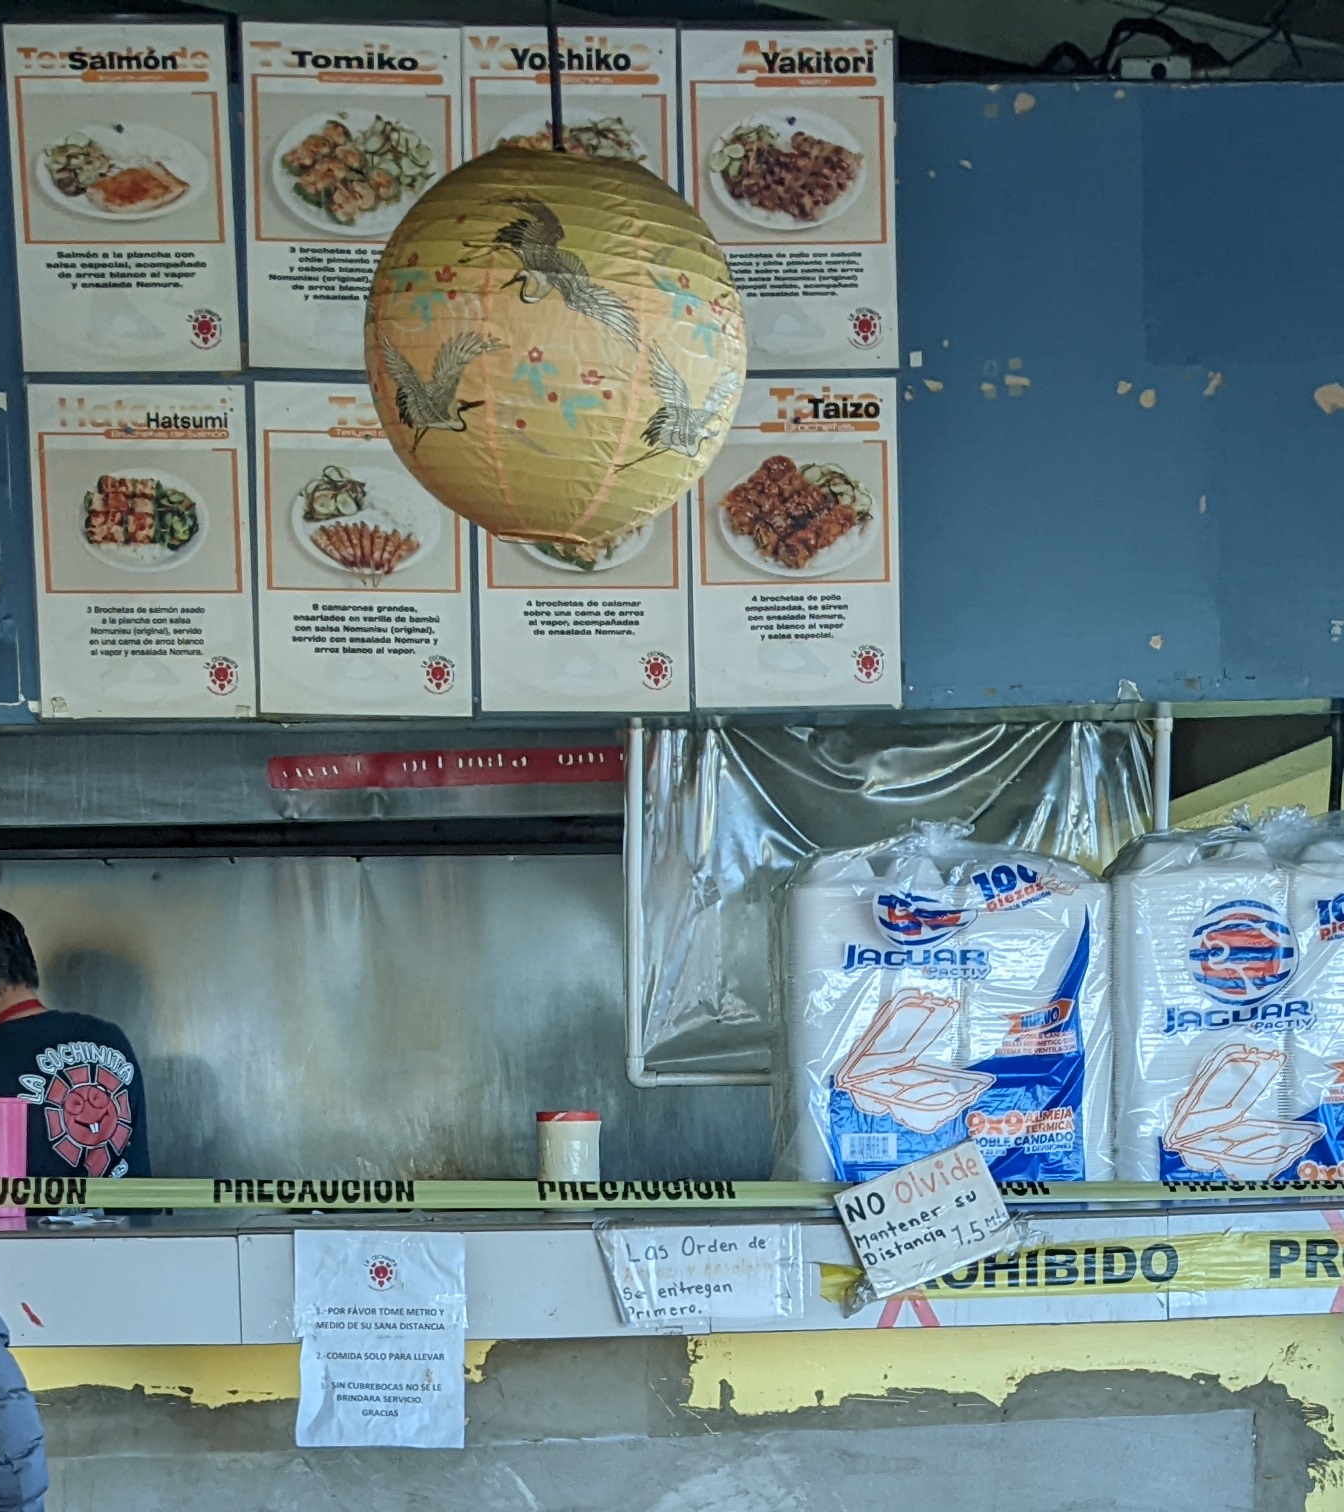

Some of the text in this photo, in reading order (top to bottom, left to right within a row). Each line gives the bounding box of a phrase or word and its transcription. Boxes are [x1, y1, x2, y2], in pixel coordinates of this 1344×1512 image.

[68, 48, 178, 70] Salmón
[291, 51, 418, 71] Tomiko
[762, 51, 874, 73] Yakitori
[808, 397, 880, 418] Taizo
[147, 412, 228, 428] Hatsumi
[843, 944, 988, 969] JAGUAR
[1163, 1001, 1311, 1033] JAGUAR
[18, 1041, 135, 1105] LA COCHINITA
[967, 1112, 1024, 1136] 9x9
[976, 1132, 1073, 1147] OBLE CANDADO
[213, 1179, 415, 1203] PRECAUCION
[844, 1153, 979, 1223] NO Olvide
[854, 1190, 977, 1248] Mantener su
[626, 1236, 766, 1262] Las Orden de
[863, 1228, 946, 1266] Distancia
[916, 1243, 1180, 1292] OHIBIDO
[658, 1281, 732, 1298] entregan
[407, 1308, 437, 1316] METRO
[414, 1353, 444, 1361] LLEVAR
[348, 1382, 403, 1390] CUBREBOCAS
[362, 1409, 399, 1417] GRACIAS
